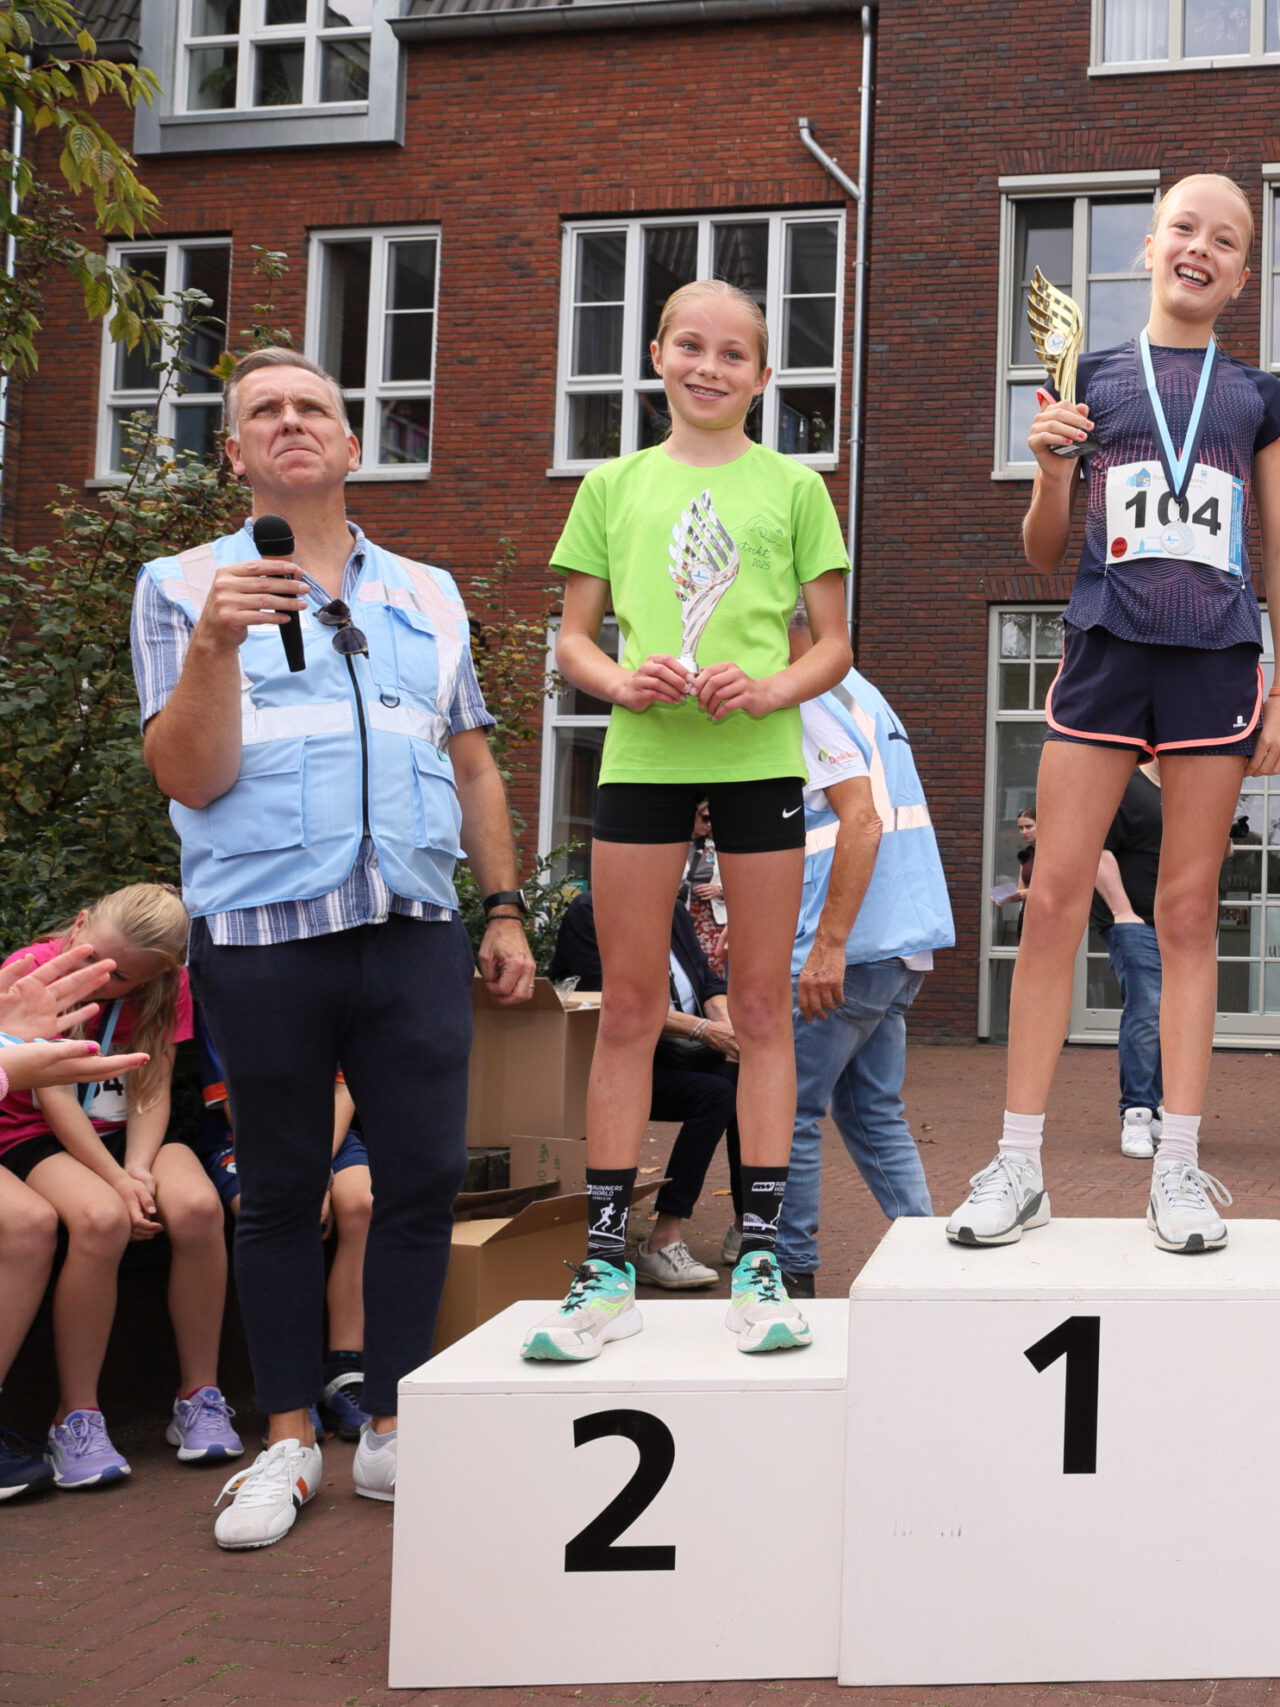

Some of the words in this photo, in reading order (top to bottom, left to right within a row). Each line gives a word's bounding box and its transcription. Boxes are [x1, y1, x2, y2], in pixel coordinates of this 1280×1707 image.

[1125, 490, 1222, 536] 104
[592, 1184, 624, 1192] RUNNERS
[1023, 1315, 1101, 1474] 1
[564, 1408, 676, 1573] 2
